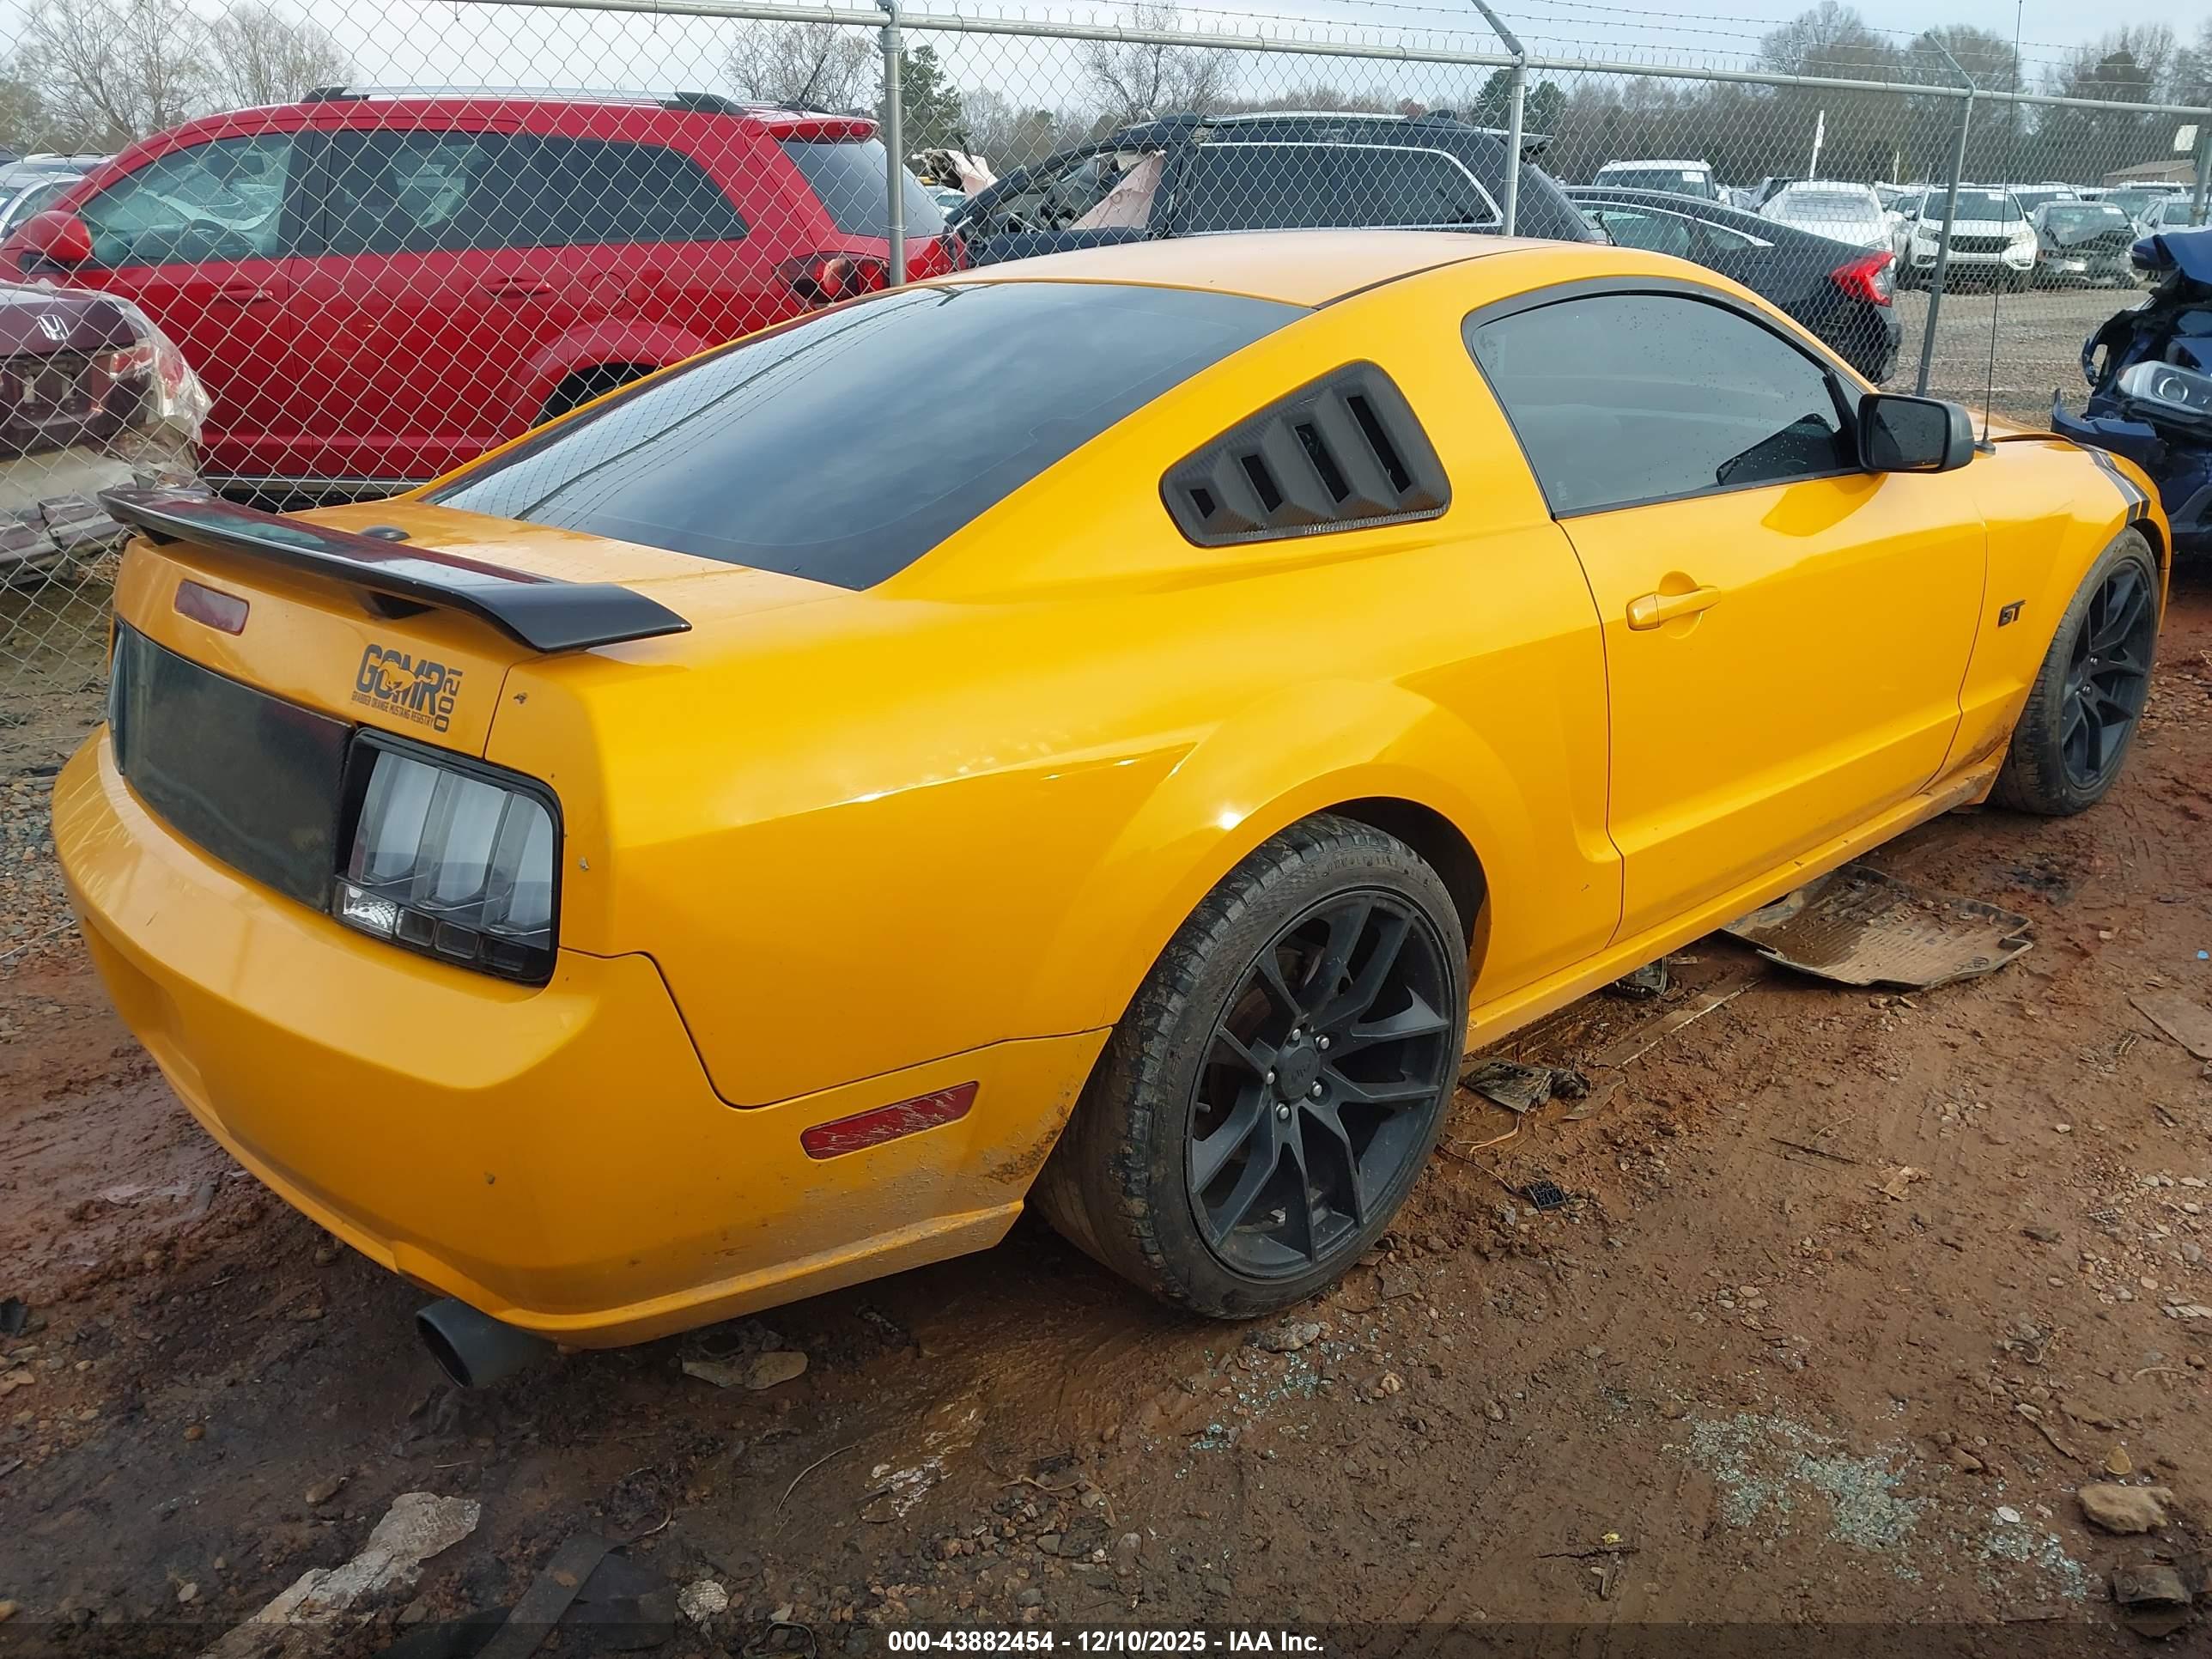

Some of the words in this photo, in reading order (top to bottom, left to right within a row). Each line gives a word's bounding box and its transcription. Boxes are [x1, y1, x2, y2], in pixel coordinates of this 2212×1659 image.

[1997, 599, 2027, 627] GT
[371, 697, 390, 713] ORANGE
[389, 703, 411, 720] MUSTANG
[410, 710, 434, 728] REGISTRY
[434, 668, 463, 732] 0021
